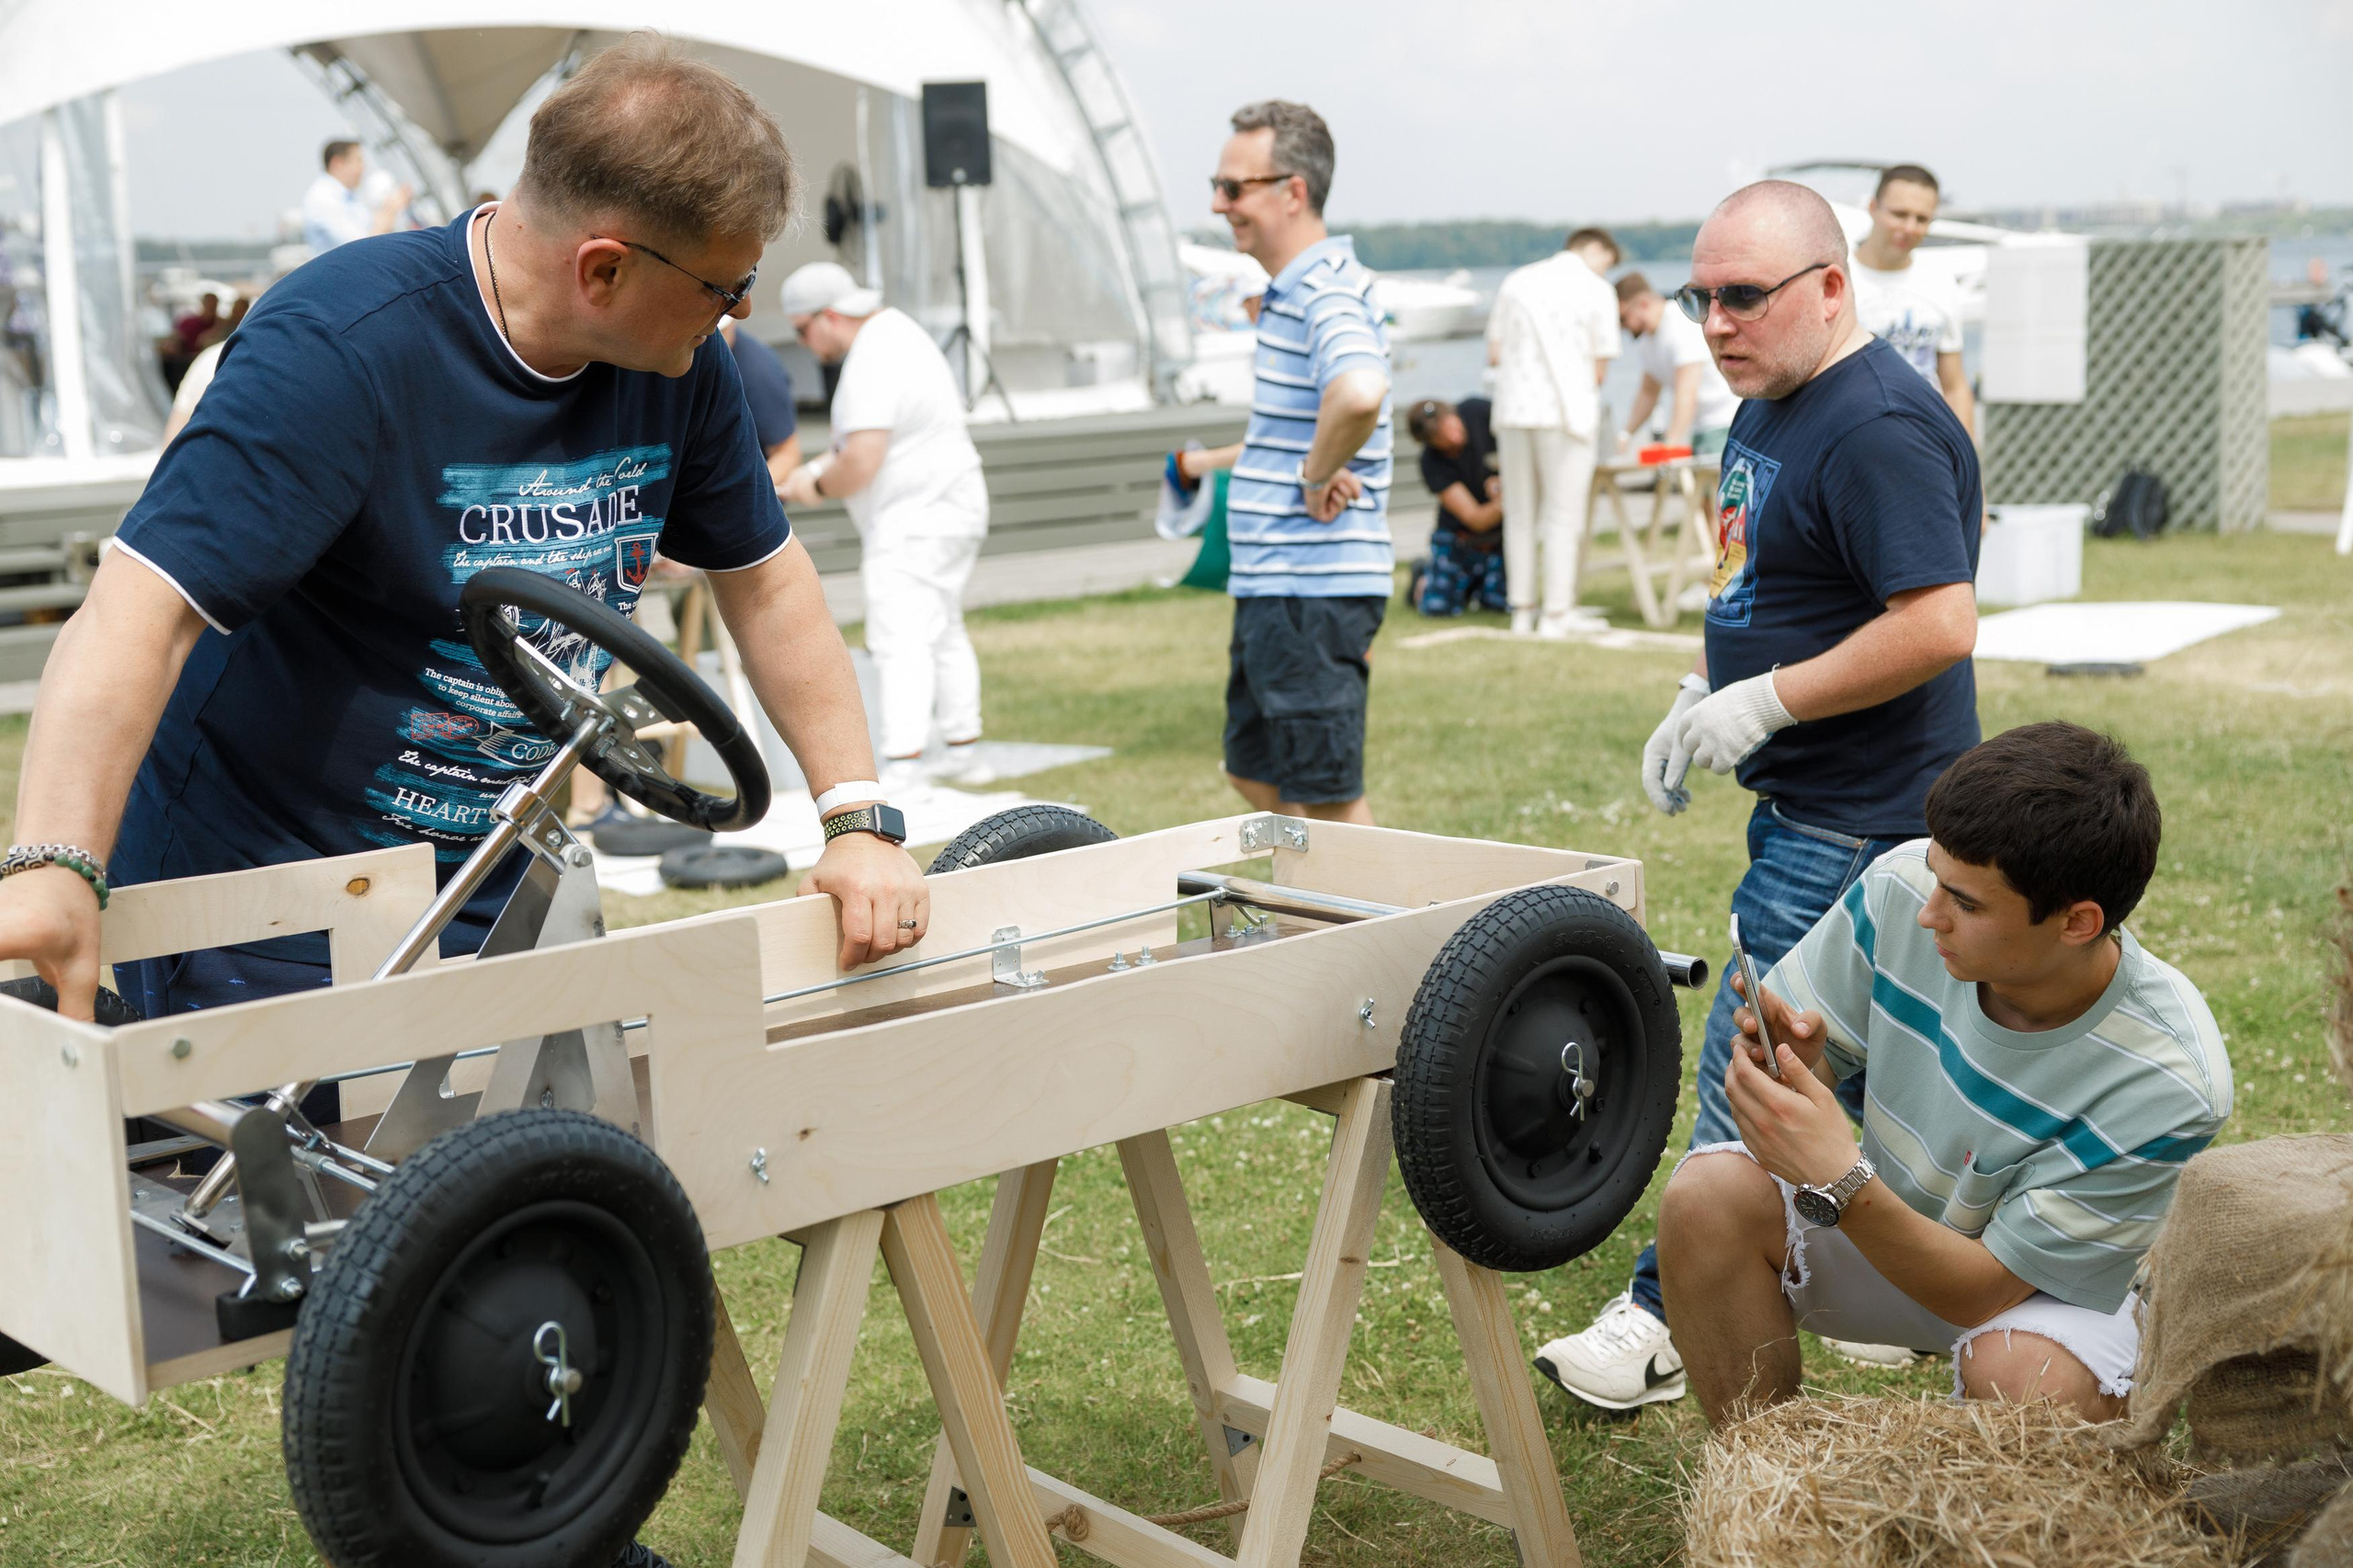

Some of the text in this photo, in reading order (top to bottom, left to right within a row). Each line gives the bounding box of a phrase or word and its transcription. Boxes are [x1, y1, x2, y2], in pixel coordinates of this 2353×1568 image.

[518, 469, 591, 497] Around
[596, 472, 614, 489] the
[460, 484, 642, 545] CRUSADE
[453, 551, 472, 568] The
[472, 551, 517, 571] captain
[520, 555, 544, 566] and
[548, 551, 568, 564] the
[618, 602, 631, 611] The
[426, 667, 507, 699] The captain is oblig
[438, 683, 447, 692] to
[448, 687, 469, 699] keep
[470, 693, 494, 706] silent
[455, 699, 497, 717] corporate
[398, 750, 421, 767] The
[424, 763, 478, 782] captain
[391, 786, 487, 824] HEART
